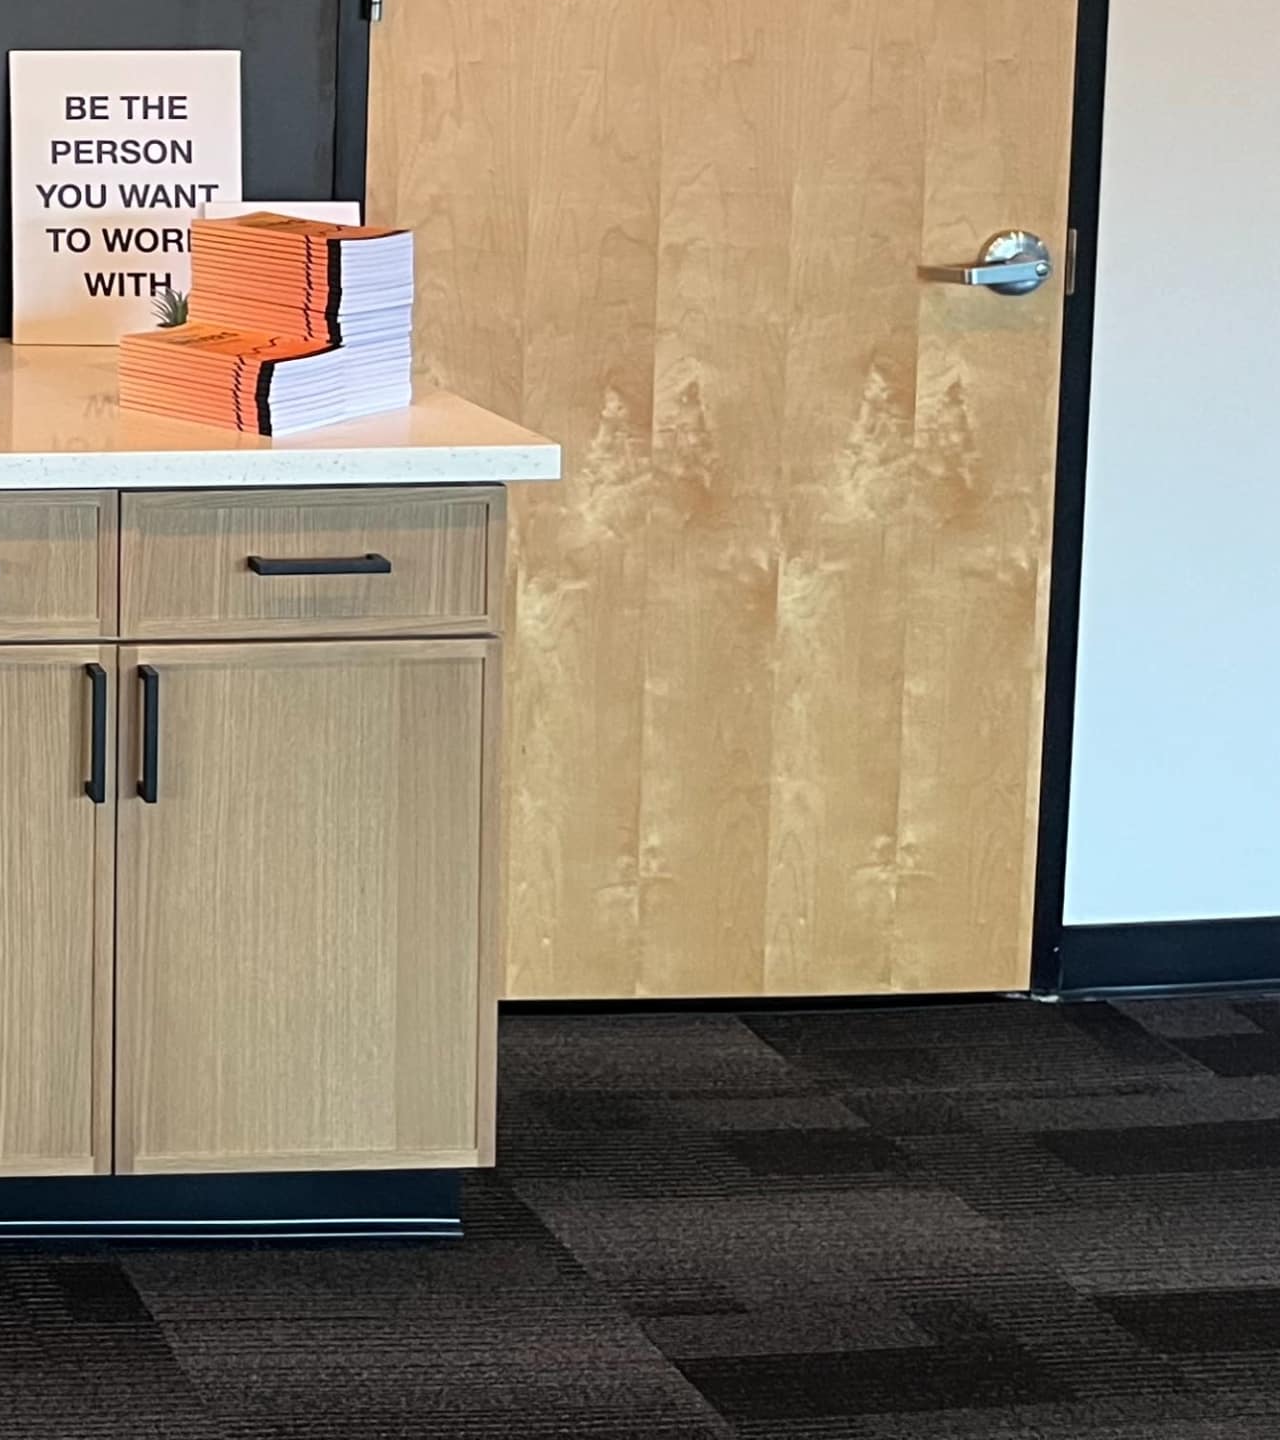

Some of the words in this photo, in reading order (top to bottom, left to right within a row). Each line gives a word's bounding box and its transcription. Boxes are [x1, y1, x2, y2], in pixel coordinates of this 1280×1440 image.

[65, 96, 110, 120] BE
[120, 96, 188, 120] THE
[51, 139, 193, 165] PERSON
[36, 183, 107, 209] YOU
[118, 184, 220, 209] WANT
[46, 227, 91, 253] TO
[101, 227, 192, 253] WOR
[84, 272, 172, 297] WITH
